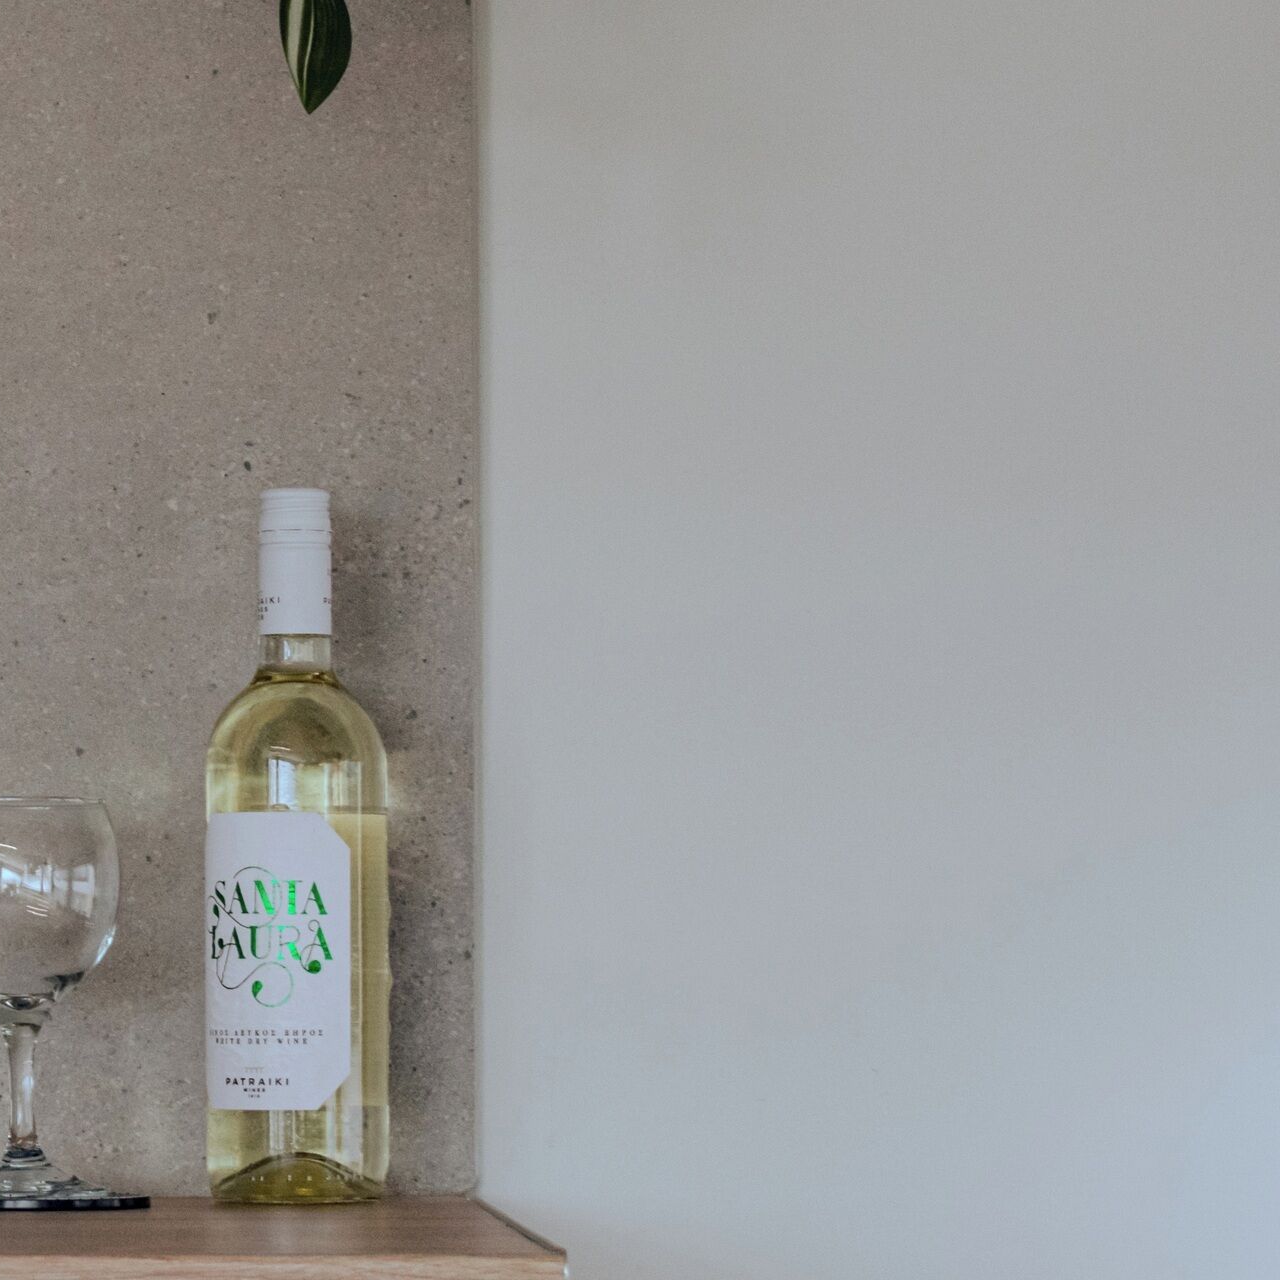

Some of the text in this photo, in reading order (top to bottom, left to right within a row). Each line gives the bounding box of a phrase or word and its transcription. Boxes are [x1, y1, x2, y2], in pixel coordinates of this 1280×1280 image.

[209, 878, 329, 918] SANTA
[208, 922, 334, 972] LAURA
[224, 1077, 290, 1086] PATRAIKI
